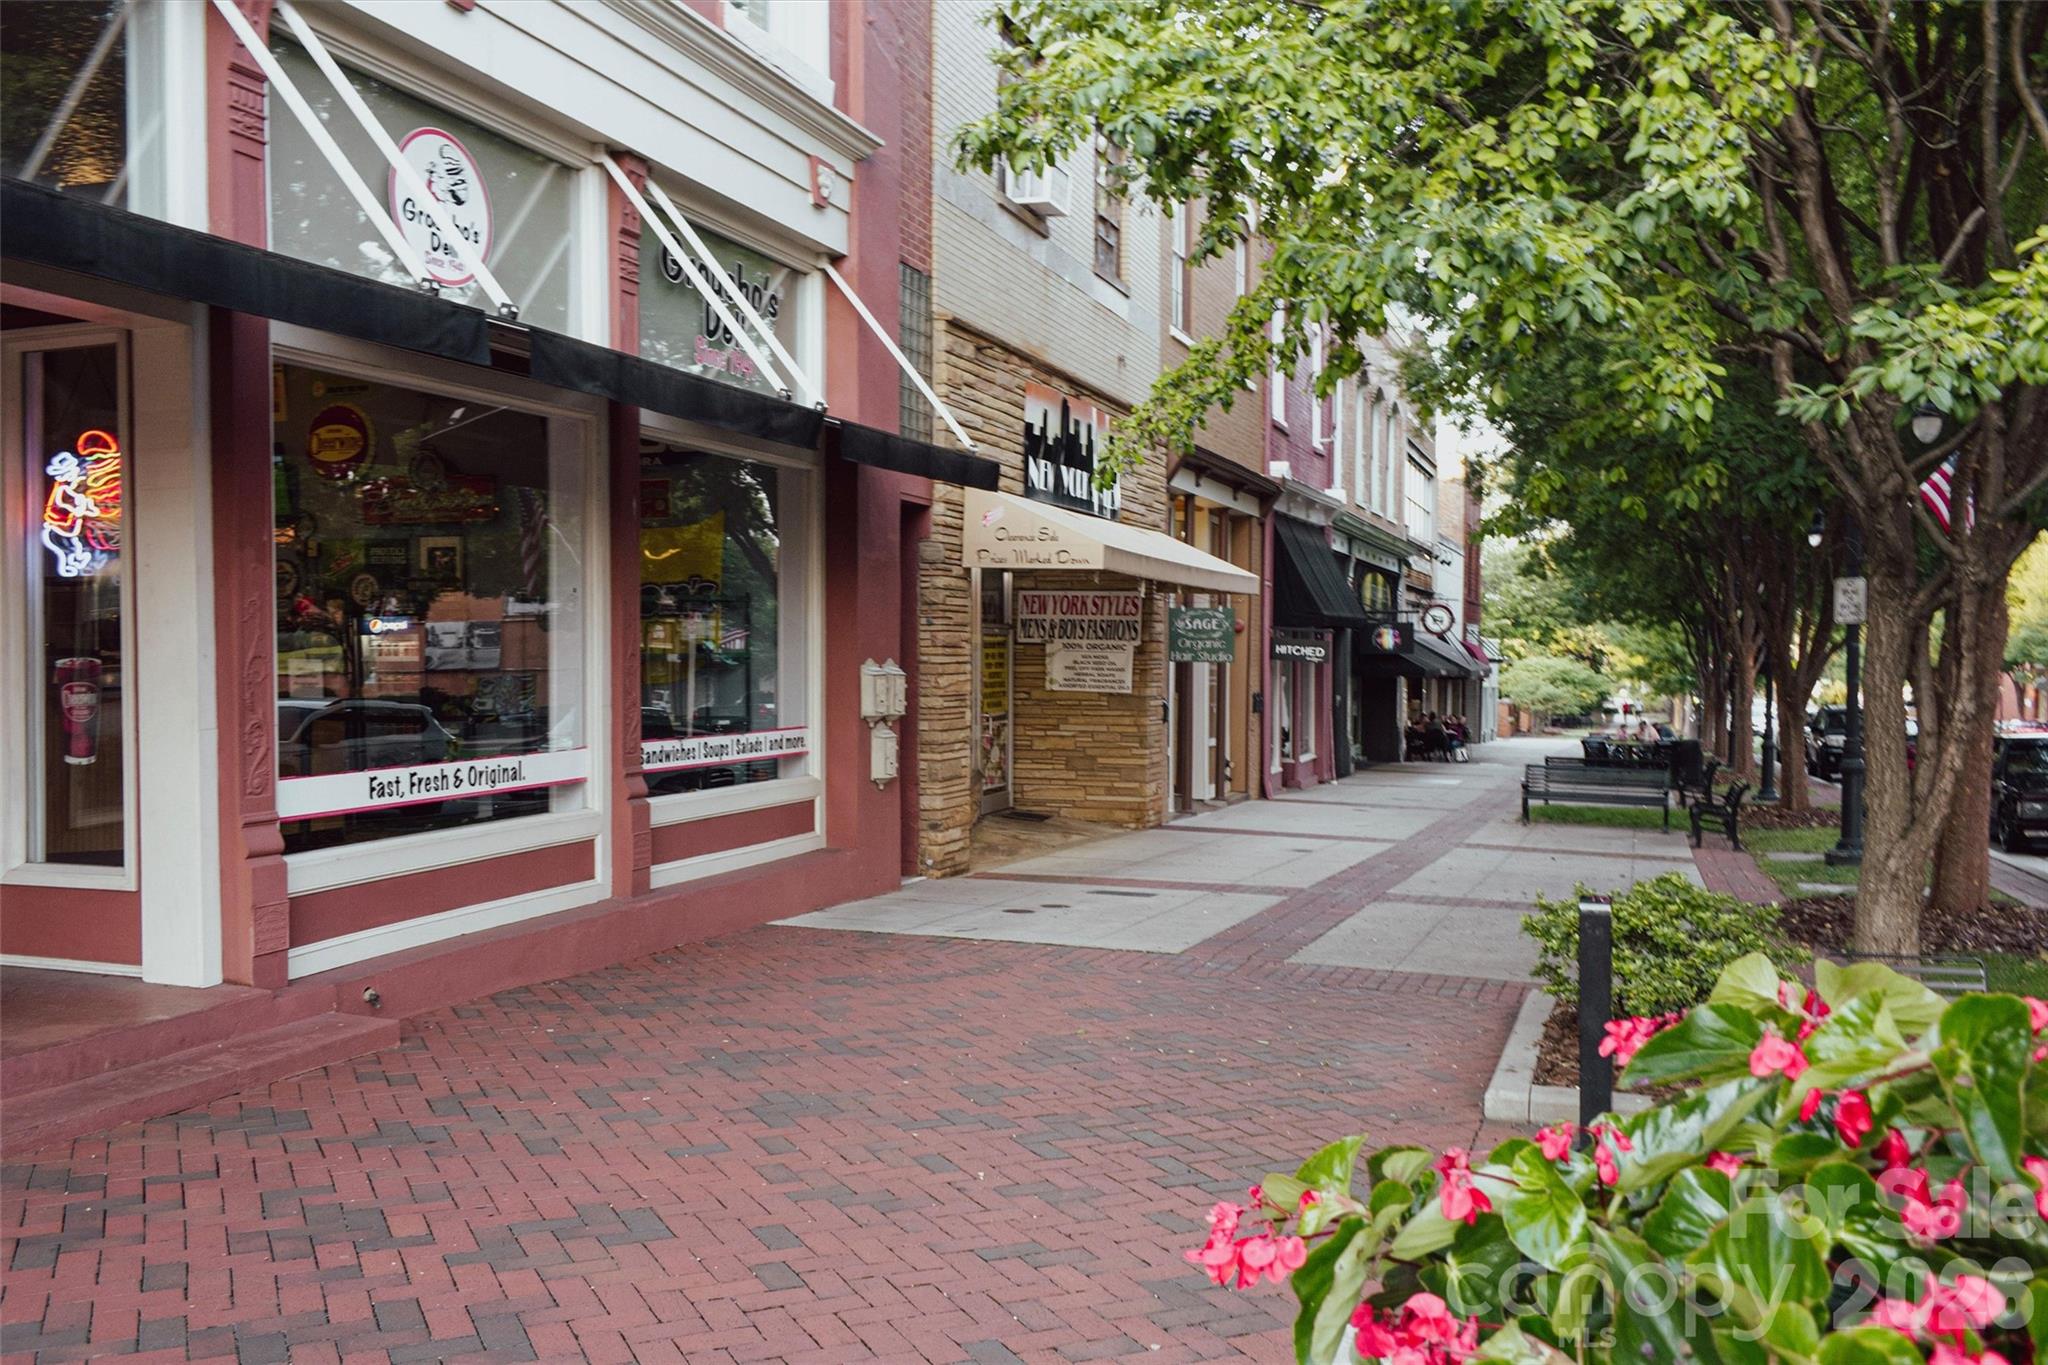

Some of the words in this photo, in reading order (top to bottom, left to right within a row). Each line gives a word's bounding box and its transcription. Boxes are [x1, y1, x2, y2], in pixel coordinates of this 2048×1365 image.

[1056, 549, 1090, 565] Down
[1020, 594, 1047, 615] NEW
[1052, 595, 1088, 616] YORK
[1090, 595, 1139, 616] STYLES
[1048, 619, 1057, 639] &
[1086, 619, 1139, 641] FASHIONS
[1184, 617, 1219, 630] SAGE
[1062, 642, 1083, 650] 100%
[1086, 643, 1128, 651] ORGANIC
[1177, 638, 1226, 650] Organic
[1274, 644, 1326, 657] HITCHED
[1170, 651, 1194, 662] Hair
[1198, 651, 1233, 662] Studio
[640, 739, 696, 765] Sandwiches
[702, 741, 730, 761] Soups
[736, 736, 763, 755] Salads
[769, 734, 784, 751] and
[785, 735, 806, 750] more.
[369, 775, 404, 799] Fast,
[409, 768, 449, 795] Fresh
[454, 767, 464, 789] &
[468, 760, 526, 788] Original.
